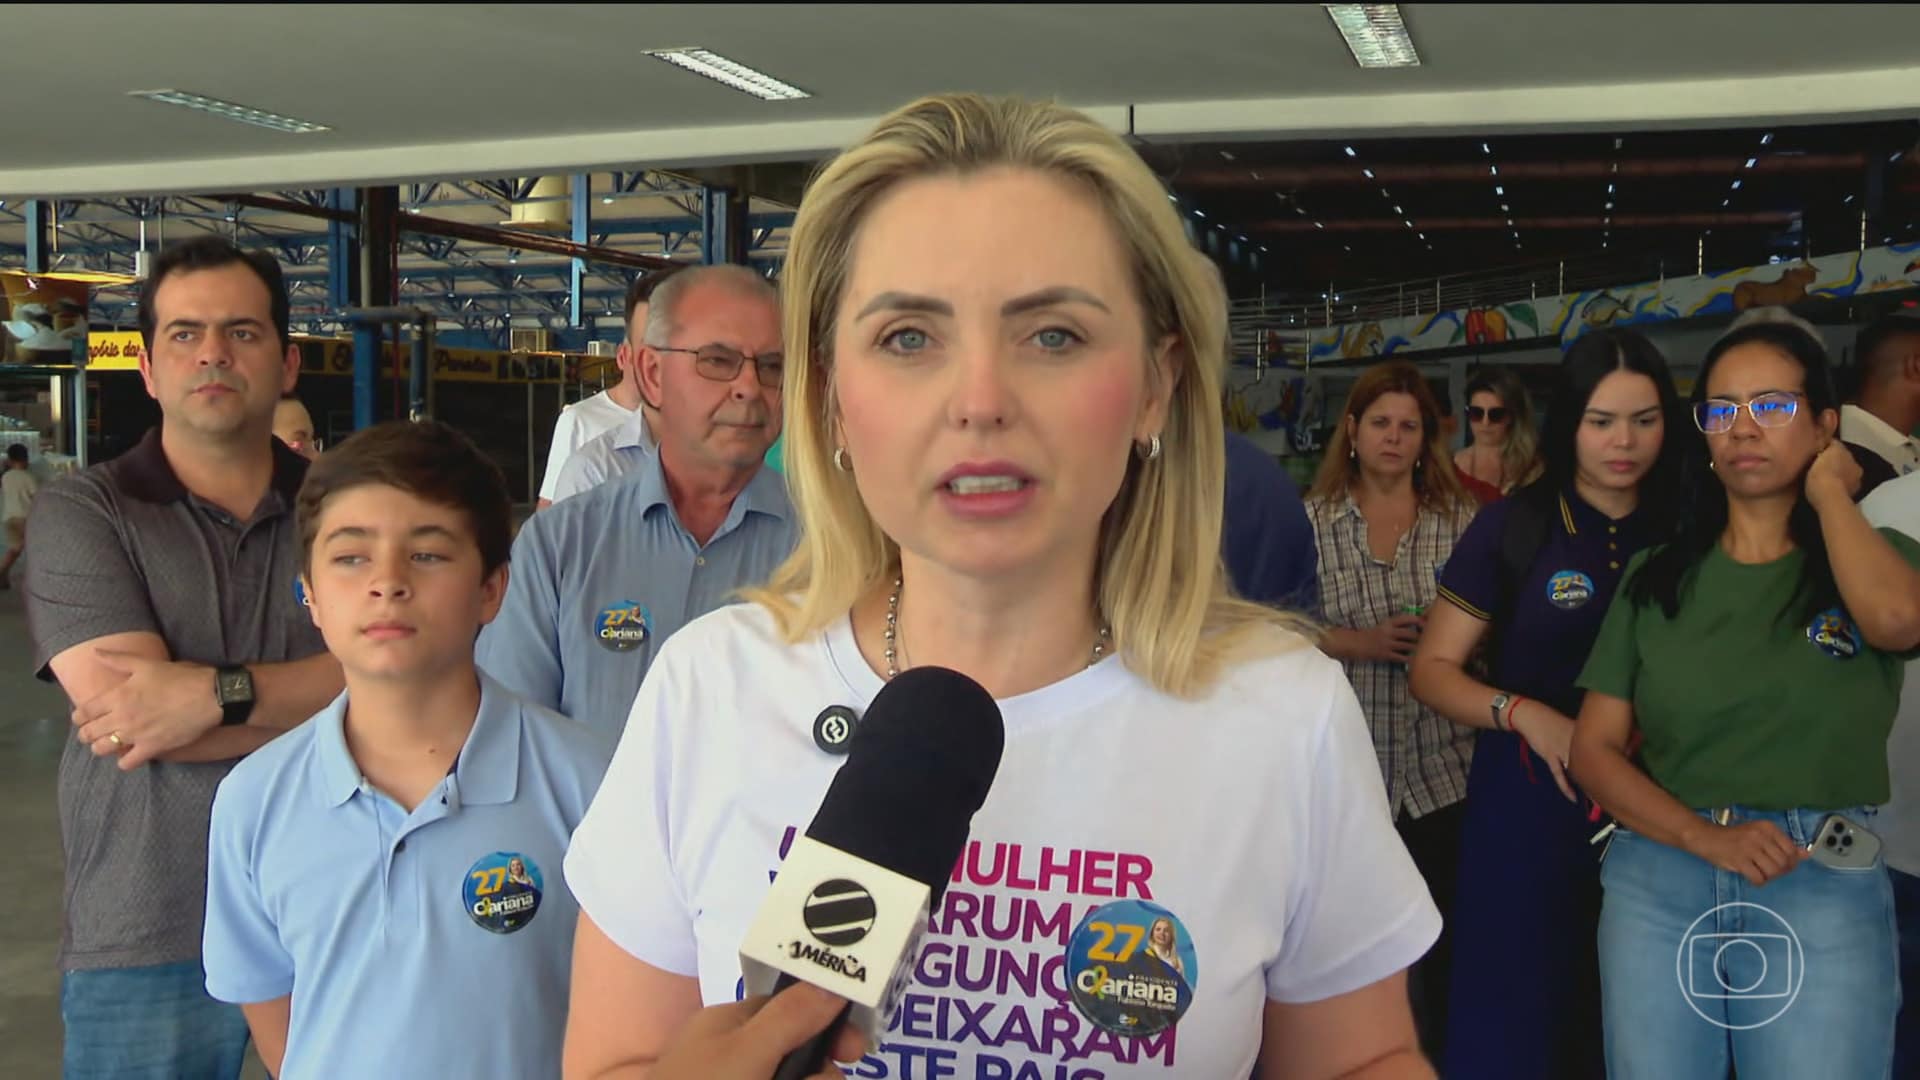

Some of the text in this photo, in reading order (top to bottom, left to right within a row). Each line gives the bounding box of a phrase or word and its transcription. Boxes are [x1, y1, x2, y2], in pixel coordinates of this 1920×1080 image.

[602, 608, 629, 626] 27
[471, 867, 506, 896] 27
[951, 841, 1154, 900] ULHER
[927, 890, 1098, 946] RUM
[1087, 920, 1146, 963] 27
[887, 993, 1176, 1067] EIXARAM
